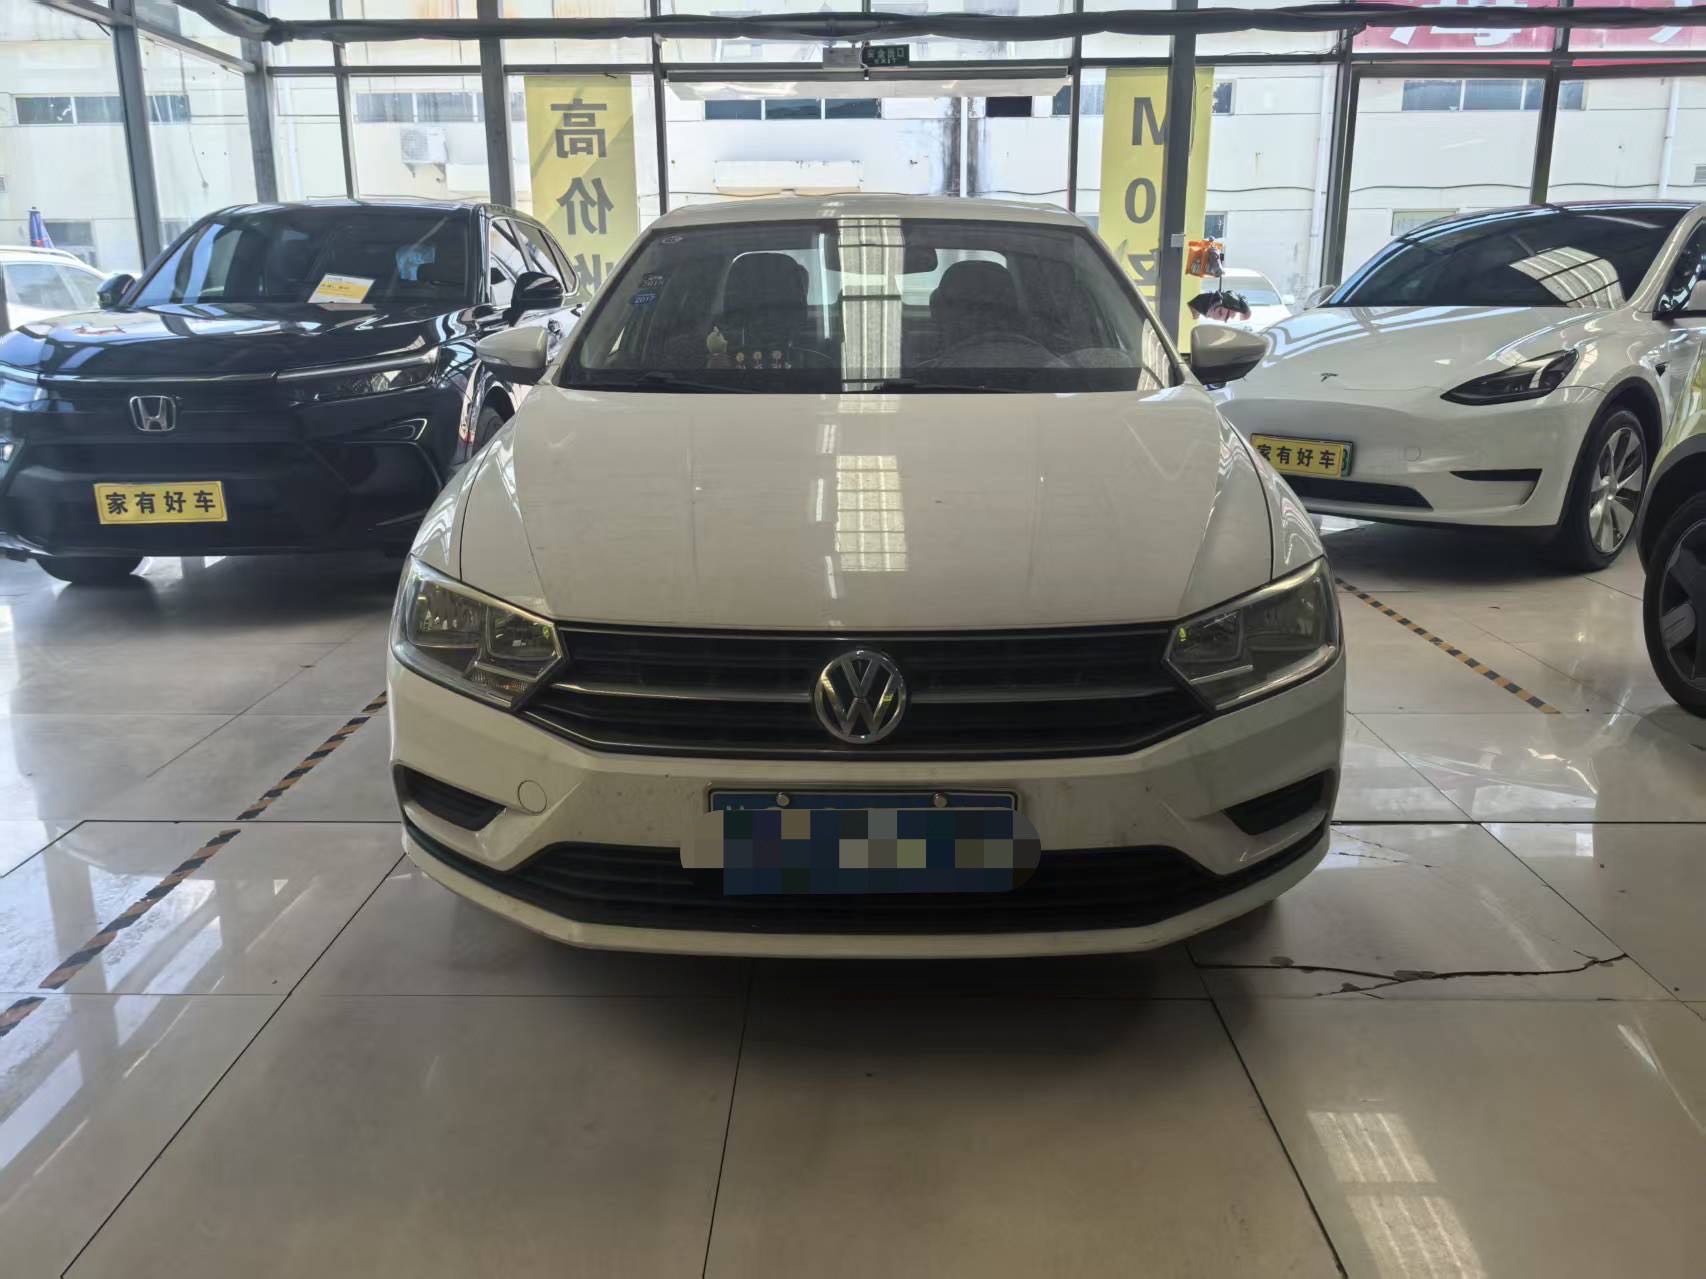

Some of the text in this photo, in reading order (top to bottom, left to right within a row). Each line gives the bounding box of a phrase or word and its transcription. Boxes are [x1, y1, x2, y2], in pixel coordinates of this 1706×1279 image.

[1257, 444, 1337, 470] 家有好车
[105, 490, 216, 515] 家有好车
